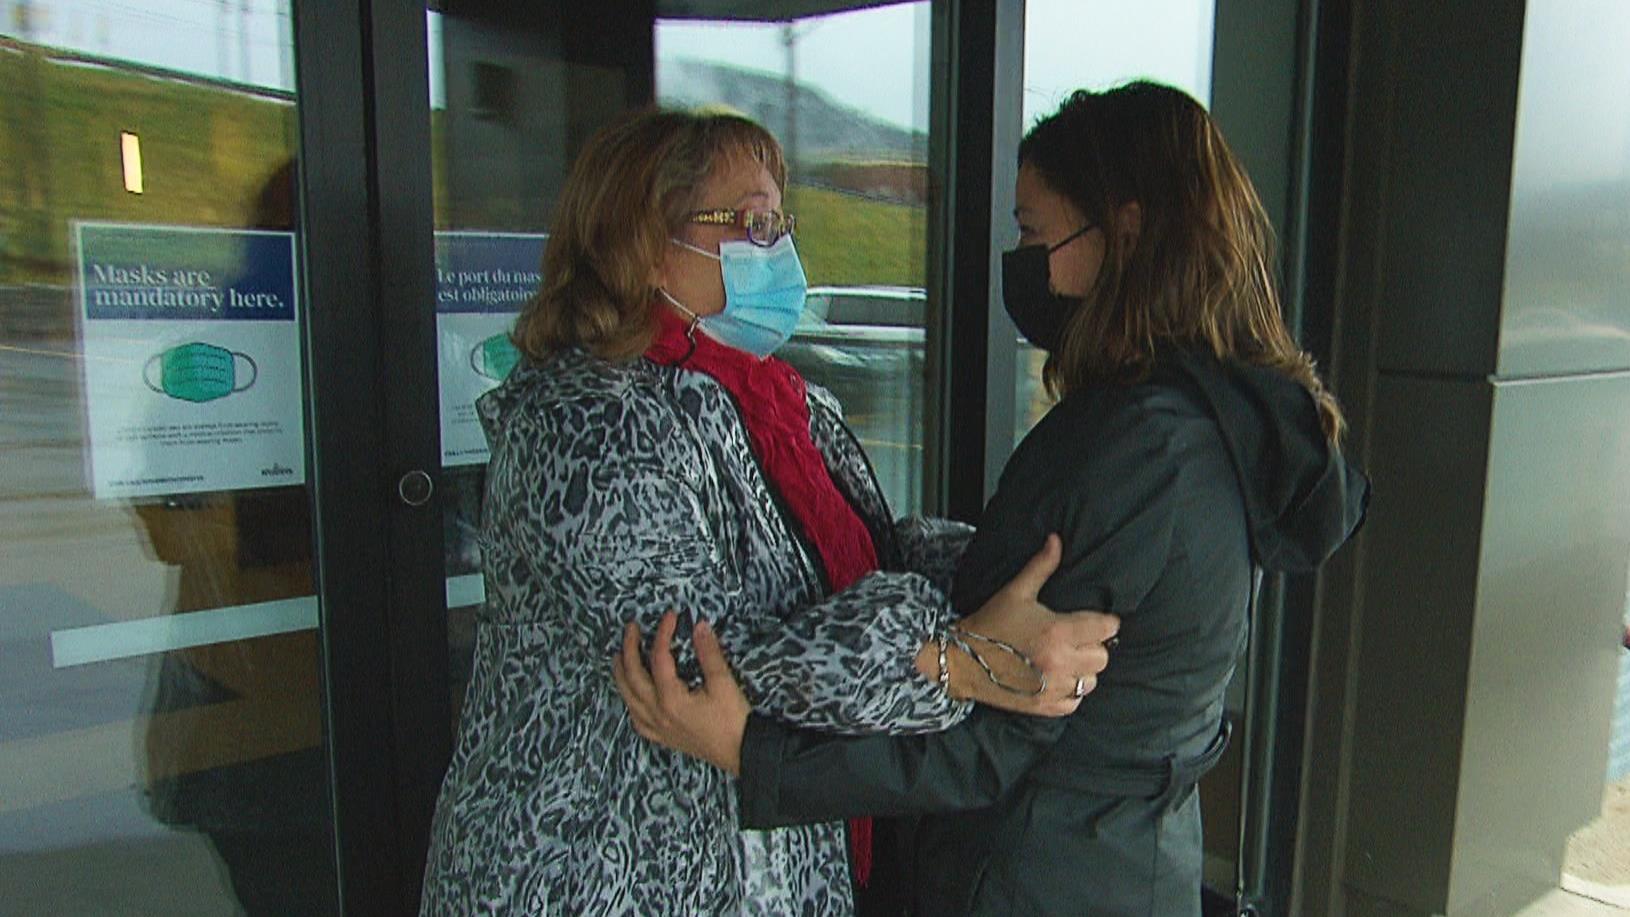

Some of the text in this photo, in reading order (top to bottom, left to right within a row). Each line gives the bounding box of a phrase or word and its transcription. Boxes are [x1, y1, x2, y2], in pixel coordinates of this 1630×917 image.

[93, 264, 210, 287] Masks are
[458, 270, 490, 287] port
[492, 268, 511, 283] du
[514, 270, 543, 283] mas
[95, 287, 285, 312] mandatory here.
[438, 286, 538, 305] est obligatoir
